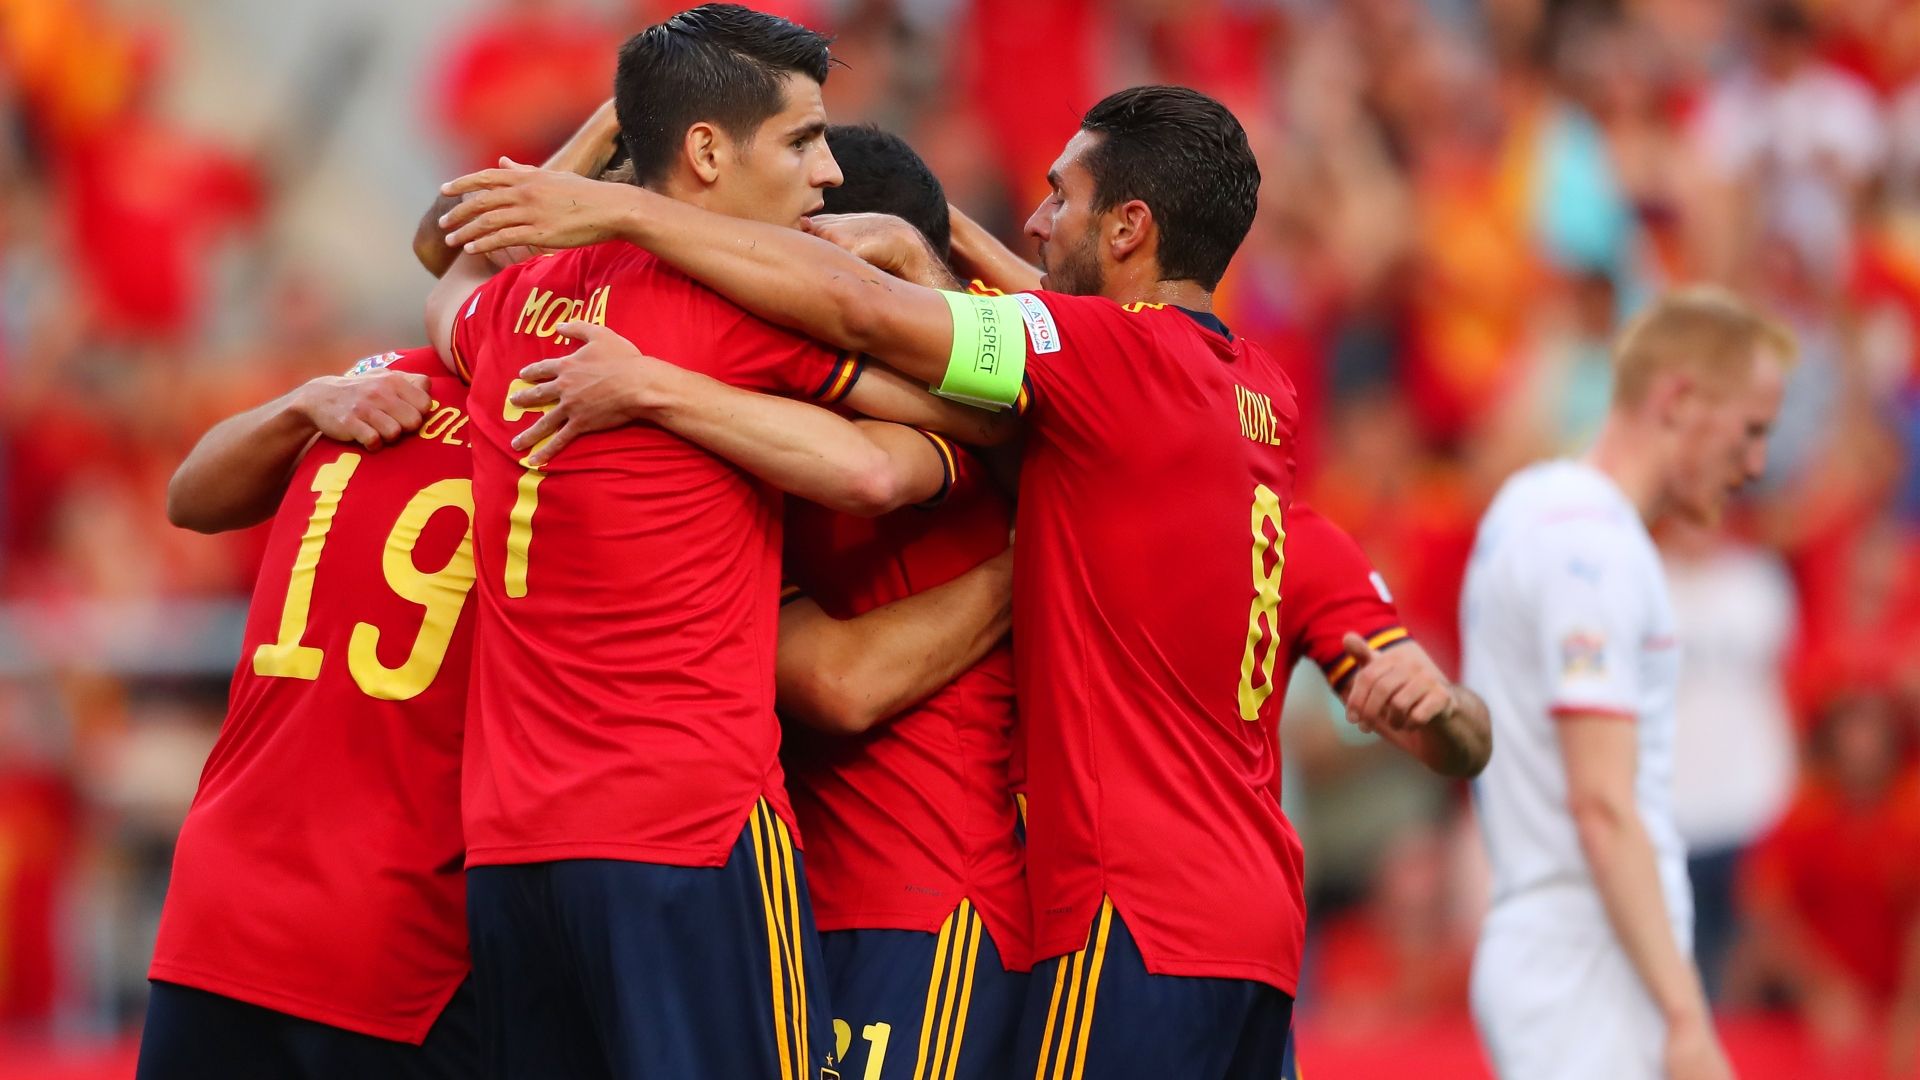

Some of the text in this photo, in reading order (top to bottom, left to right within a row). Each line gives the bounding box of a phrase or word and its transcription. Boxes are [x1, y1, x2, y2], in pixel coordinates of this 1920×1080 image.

[980, 308, 997, 374] RESPECT
[253, 452, 477, 700] 19
[1238, 484, 1285, 721] 8
